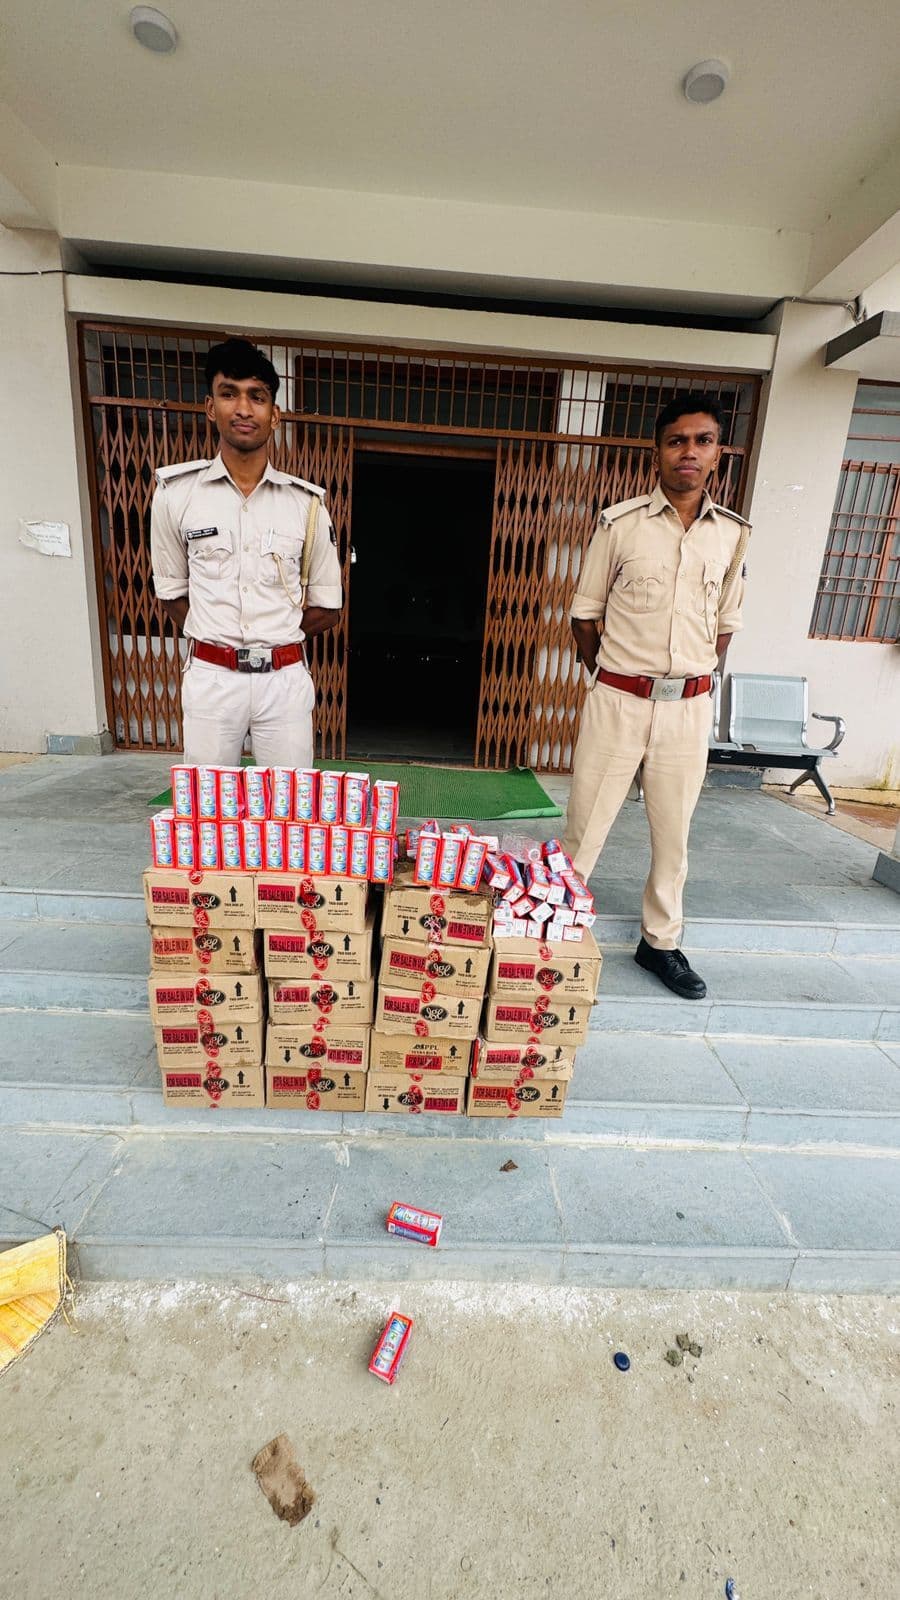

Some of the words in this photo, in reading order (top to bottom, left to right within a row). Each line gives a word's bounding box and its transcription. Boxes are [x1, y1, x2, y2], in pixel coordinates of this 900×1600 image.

[392, 953, 400, 964] FOR
[401, 955, 412, 967] SALE
[157, 991, 167, 1001] FOR
[167, 991, 180, 1001] SALE
[180, 991, 186, 1001] IN
[384, 999, 393, 1010] FOR
[394, 1000, 405, 1012] SALE
